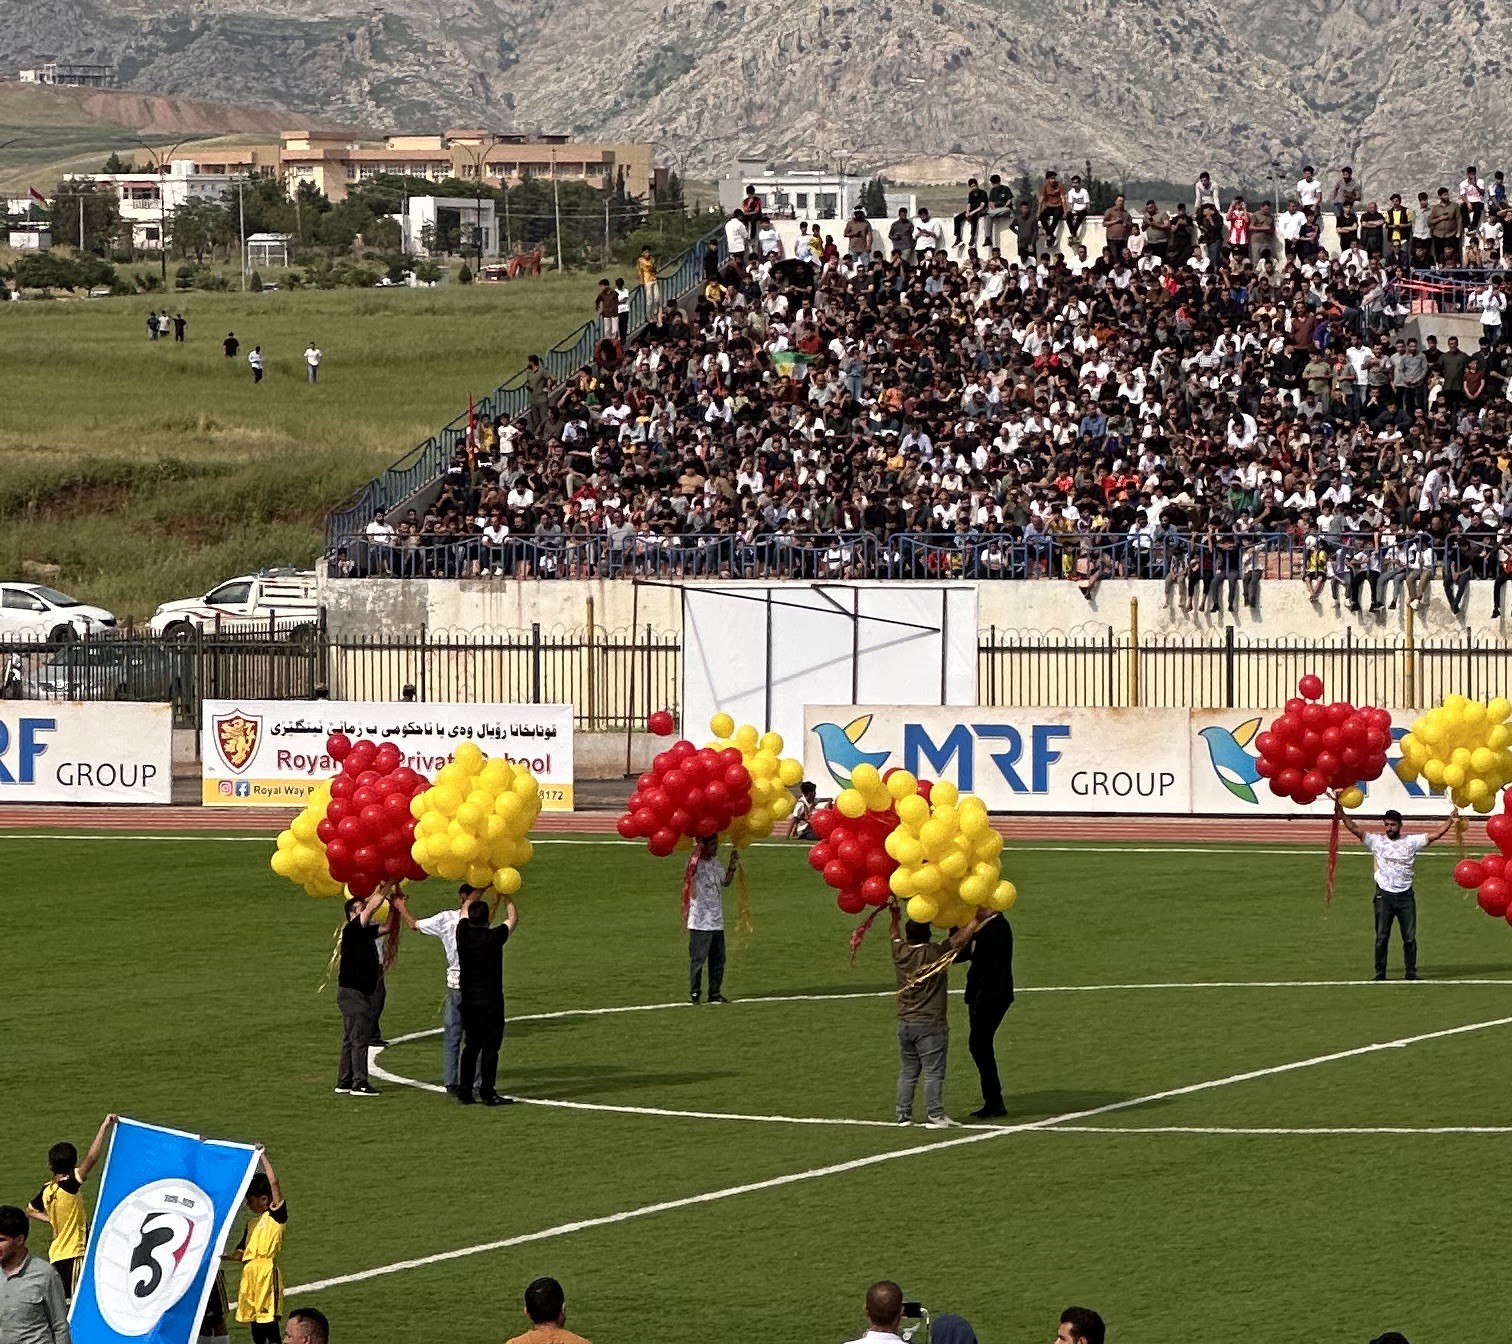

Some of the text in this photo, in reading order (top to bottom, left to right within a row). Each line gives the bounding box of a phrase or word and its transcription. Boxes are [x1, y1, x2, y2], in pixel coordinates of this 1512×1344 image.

[904, 723, 1072, 793] MRF
[56, 762, 157, 787] GROUP
[1070, 771, 1175, 797] GROUP
[254, 785, 281, 797] Royal
[285, 786, 305, 797] Way
